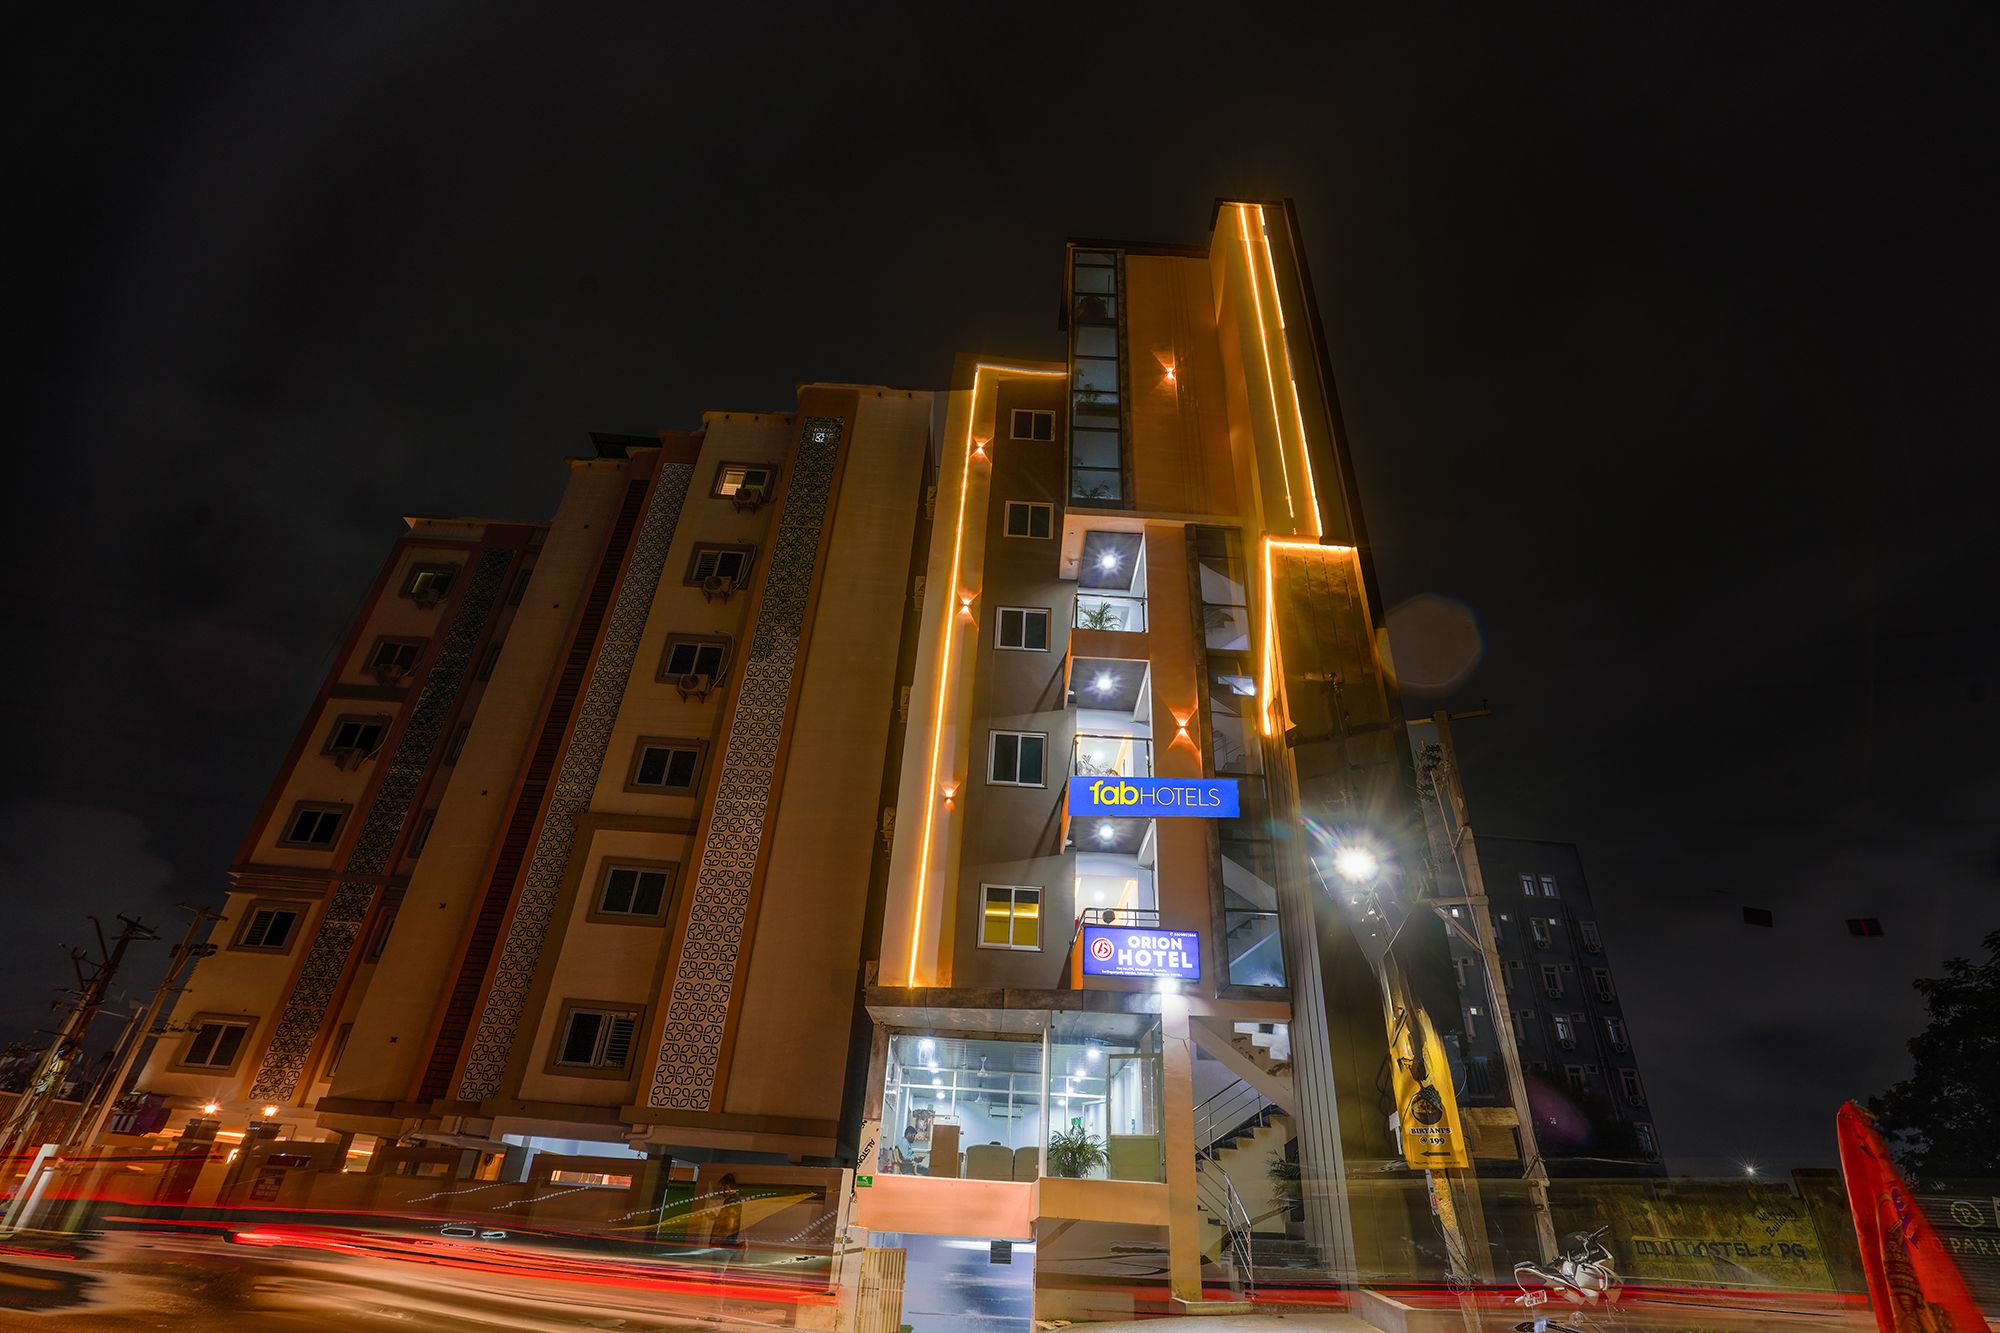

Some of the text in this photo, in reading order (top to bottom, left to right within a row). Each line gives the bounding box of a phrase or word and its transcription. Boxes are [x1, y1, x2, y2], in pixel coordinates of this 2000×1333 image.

[1089, 780, 1221, 807] fabHOTELS
[1127, 935, 1183, 951] ORION
[1117, 948, 1193, 969] HOTEL
[1429, 1137, 1446, 1145] 199
